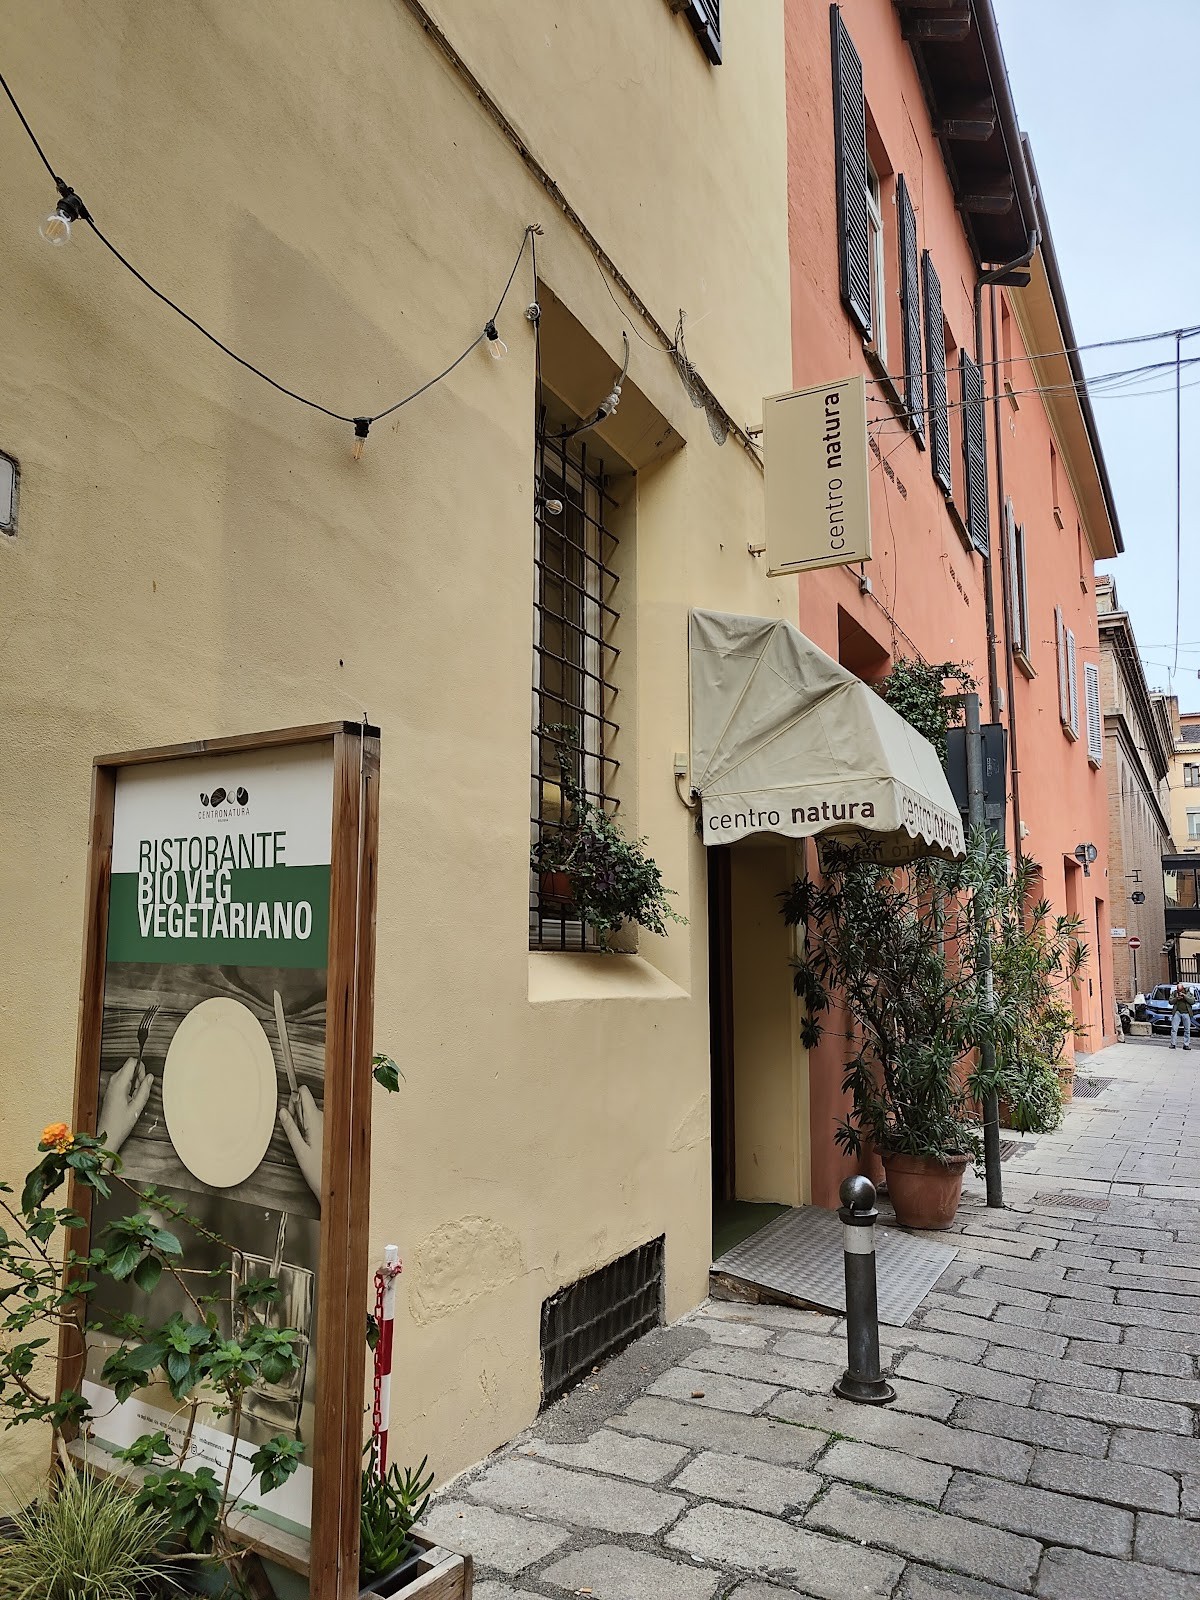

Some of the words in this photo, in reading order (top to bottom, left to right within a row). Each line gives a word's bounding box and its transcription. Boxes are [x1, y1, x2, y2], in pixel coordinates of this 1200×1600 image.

[822, 392, 842, 469] natura
[825, 478, 845, 550] centro
[198, 807, 250, 820] CENTRONATURA
[709, 808, 780, 831] centro
[791, 801, 875, 824] natura
[902, 796, 932, 835] centro
[934, 812, 961, 849] natura
[139, 830, 287, 872] RISTORANTE
[138, 868, 178, 905] BIO
[185, 867, 232, 904] VEG
[138, 900, 313, 940] VEGETARIANO
